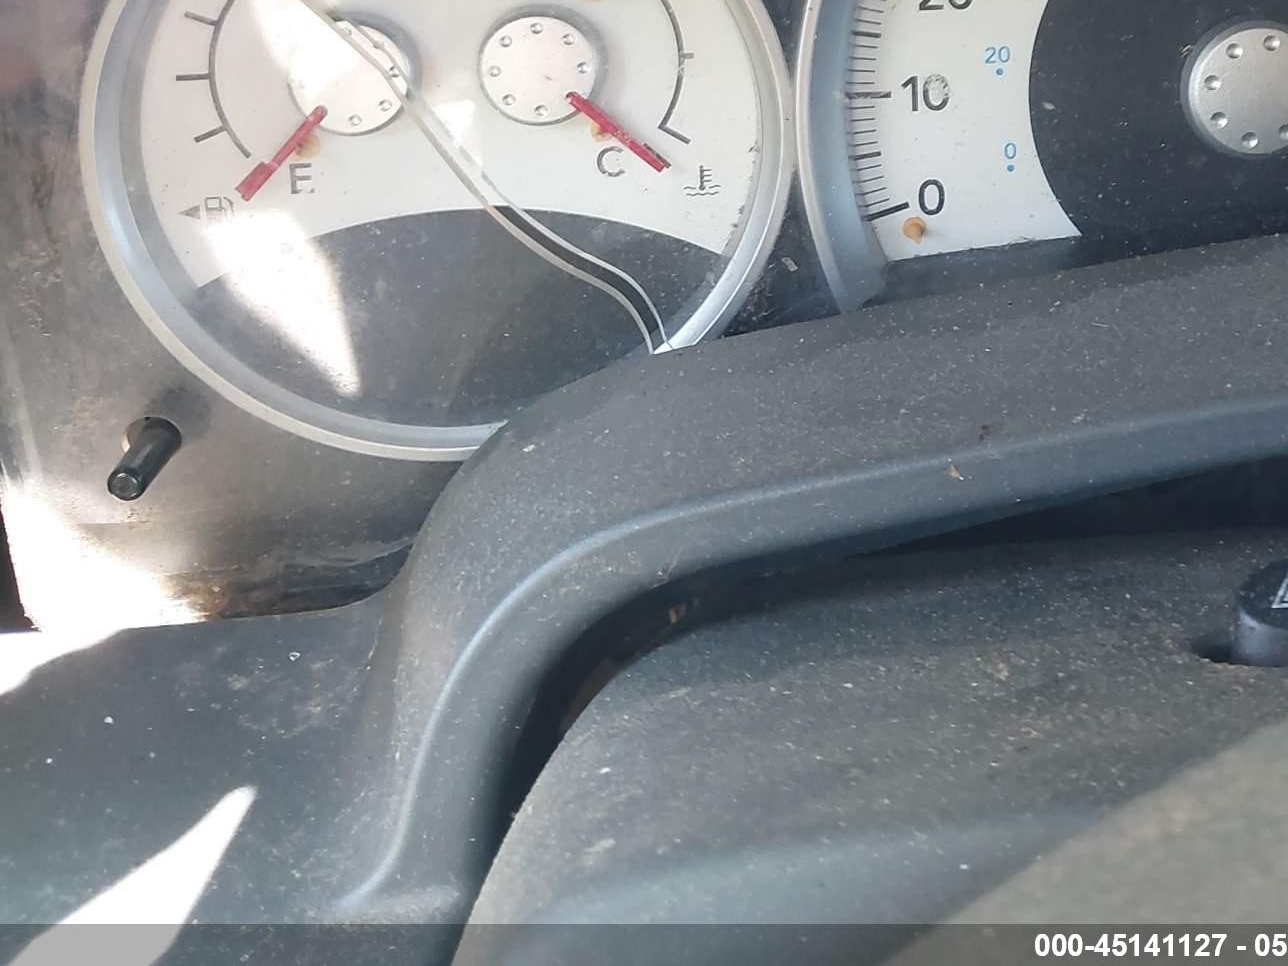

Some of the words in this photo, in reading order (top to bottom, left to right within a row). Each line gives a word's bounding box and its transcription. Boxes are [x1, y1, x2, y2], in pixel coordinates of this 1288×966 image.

[984, 45, 1011, 65] 20
[900, 74, 951, 113] 10
[595, 145, 624, 179] C
[1003, 141, 1017, 160] 0
[288, 162, 314, 195] E
[917, 177, 946, 216] 0
